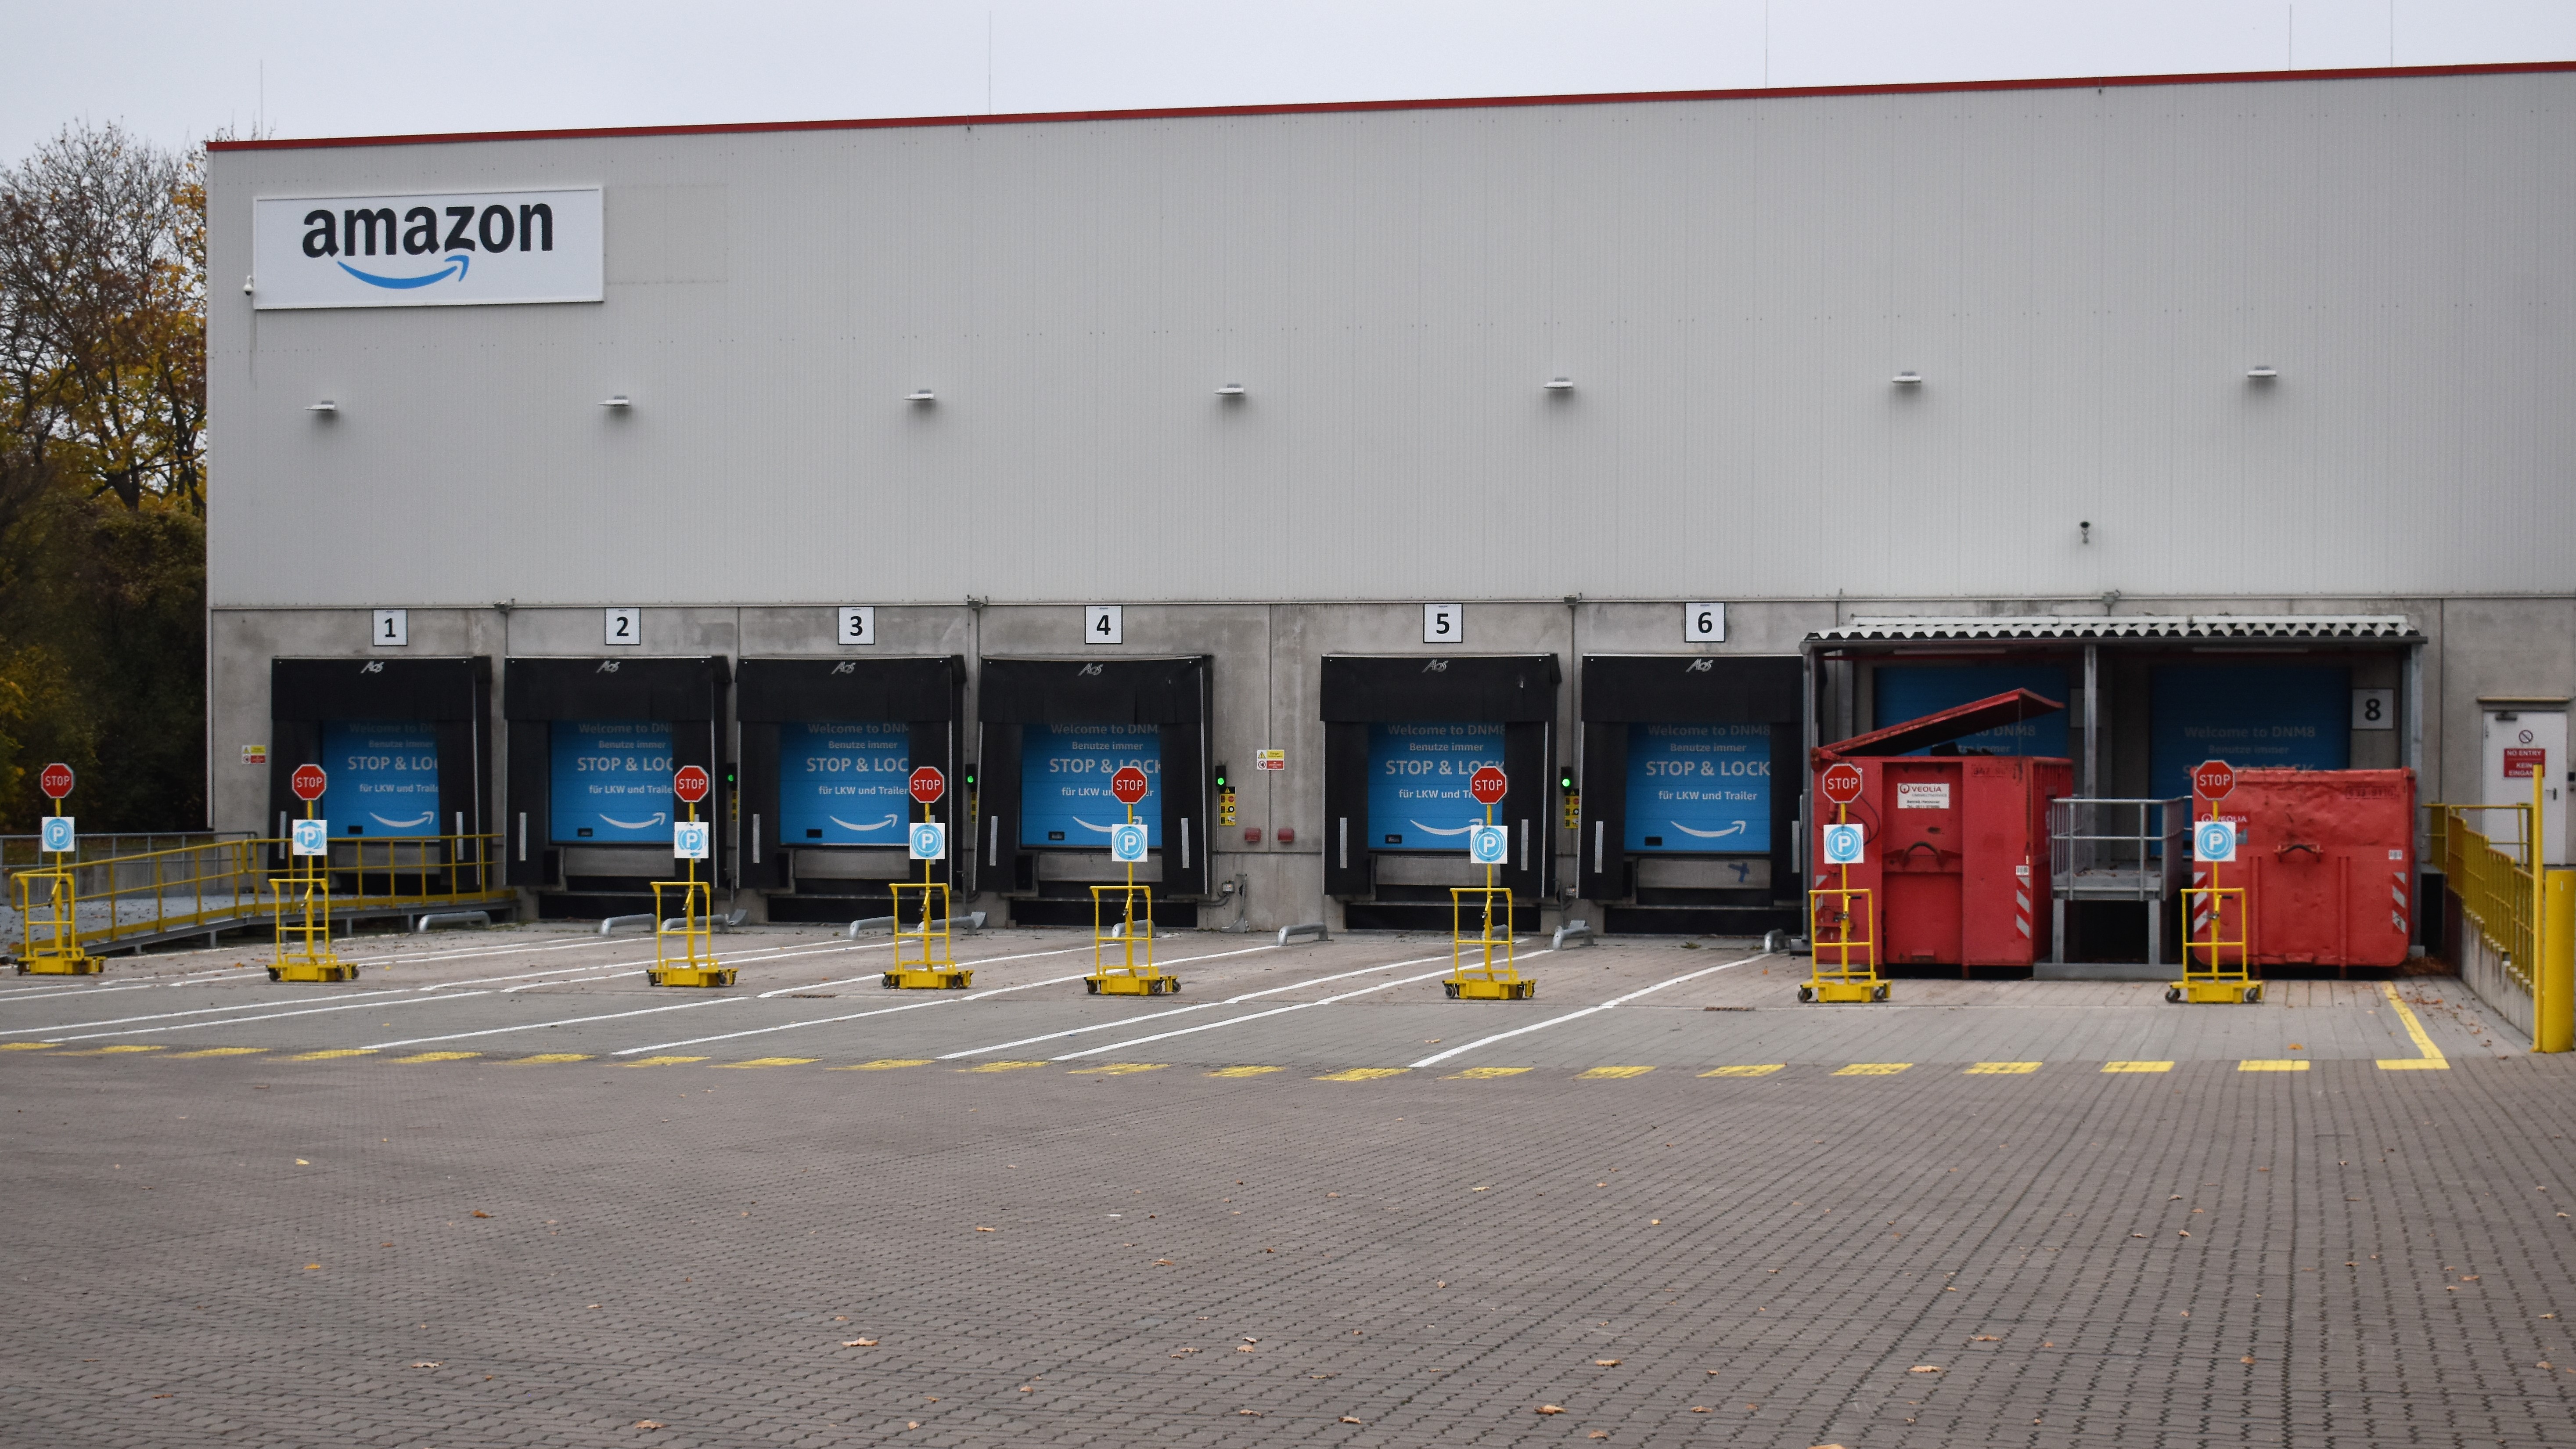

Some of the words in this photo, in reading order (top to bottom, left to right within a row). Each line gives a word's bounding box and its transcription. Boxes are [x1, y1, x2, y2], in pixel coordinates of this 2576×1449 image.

[302, 203, 553, 258] amazon
[385, 618, 396, 638] 1
[616, 616, 629, 637] 2
[850, 616, 863, 636] 3
[1096, 615, 1111, 635] 4
[1436, 613, 1450, 634] 5
[1698, 612, 1713, 634] 6
[2364, 698, 2381, 721] 8
[349, 724, 401, 733] Welcome
[405, 724, 416, 733] to
[420, 724, 438, 733] DN
[579, 724, 632, 733] Welcome
[651, 724, 673, 733] DN
[808, 724, 863, 734] Welcome
[866, 725, 879, 733] to
[882, 724, 909, 733] DNM
[1050, 724, 1107, 734] Welcome
[1111, 725, 1124, 734] to
[1128, 724, 1159, 734] DNM
[1388, 724, 1446, 735] Welcome
[1450, 725, 1463, 735] to
[1648, 725, 1708, 736] Welcome
[1712, 726, 1726, 736] to
[1731, 725, 1770, 736] DNM8
[1994, 725, 2036, 736] DNM8
[2184, 726, 2248, 738] Welcome
[2253, 727, 2267, 738] to
[2272, 726, 2316, 738] DNM8
[599, 740, 635, 748] Benutze
[1113, 742, 1143, 750] immer
[1410, 743, 1449, 751] Benutze
[1452, 743, 1484, 751] immer
[1670, 743, 1710, 752] Benutze
[1713, 743, 1747, 752] immer
[2209, 745, 2251, 754] Benutze
[348, 756, 390, 770] STOP
[396, 756, 407, 770] &
[412, 756, 438, 770] LO
[577, 757, 621, 771] STOP
[626, 757, 638, 771] &
[643, 757, 673, 771] LOC
[806, 757, 852, 772] STOP
[856, 757, 869, 772] &
[874, 757, 908, 772] LOC
[1049, 758, 1096, 773] STOP
[1100, 759, 1114, 773] &
[1385, 760, 1434, 775] STOP
[1439, 760, 1453, 775] &
[1646, 761, 1695, 776] STOP
[1701, 761, 1715, 776] &
[1720, 761, 1770, 776] LOCK
[45, 775, 70, 786] STOP
[296, 777, 323, 787] STOP
[679, 779, 705, 789] STOP
[914, 779, 941, 790] STOP
[1116, 779, 1144, 791] STOP
[1475, 779, 1503, 791] STOP
[1828, 778, 1858, 789] STOP
[2199, 774, 2231, 786] STOP
[360, 784, 372, 792] für
[397, 784, 414, 792] und
[416, 784, 439, 792] Traile
[589, 785, 603, 793] für
[604, 785, 625, 793] LKW
[627, 785, 644, 793] und
[647, 785, 673, 793] Traile
[819, 786, 832, 794] für
[859, 786, 876, 794] und
[1061, 787, 1076, 796] für
[1078, 788, 1100, 796] LKW
[1399, 789, 1413, 798] für
[1416, 790, 1438, 798] LKW
[1441, 789, 1460, 798] und
[1659, 791, 1673, 800] für
[1676, 792, 1699, 800] LKW
[1702, 791, 1721, 800] und
[1724, 791, 1757, 800] Trailer
[53, 827, 64, 842] P
[305, 829, 316, 844] P
[687, 833, 698, 847] P
[922, 833, 933, 848] P
[1125, 835, 1136, 851] P
[1484, 836, 1496, 853] P
[1838, 835, 1851, 852] P
[2209, 833, 2223, 850] P
